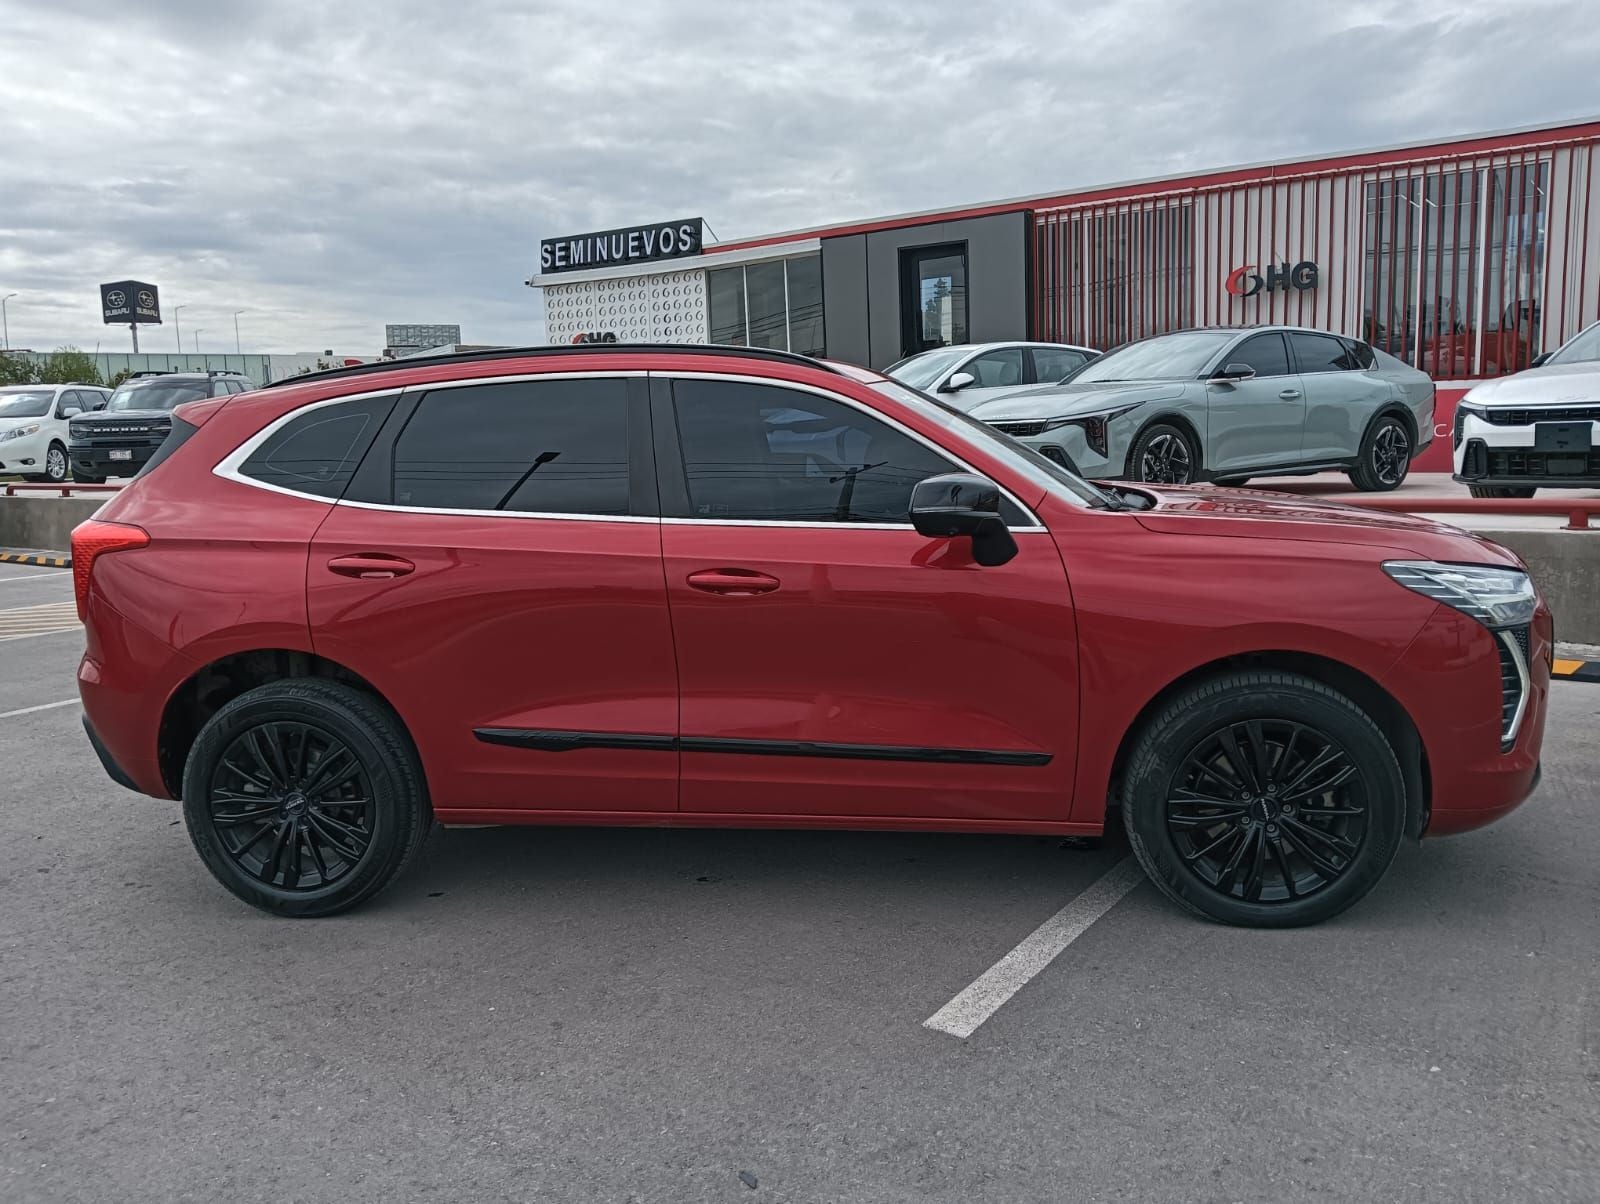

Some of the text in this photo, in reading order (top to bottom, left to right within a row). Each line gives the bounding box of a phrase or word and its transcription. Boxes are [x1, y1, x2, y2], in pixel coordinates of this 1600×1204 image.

[541, 225, 691, 268] SEMINUEVOS
[1266, 261, 1318, 292] HG
[105, 307, 130, 317] SUBARU
[136, 307, 158, 317] SUBARU
